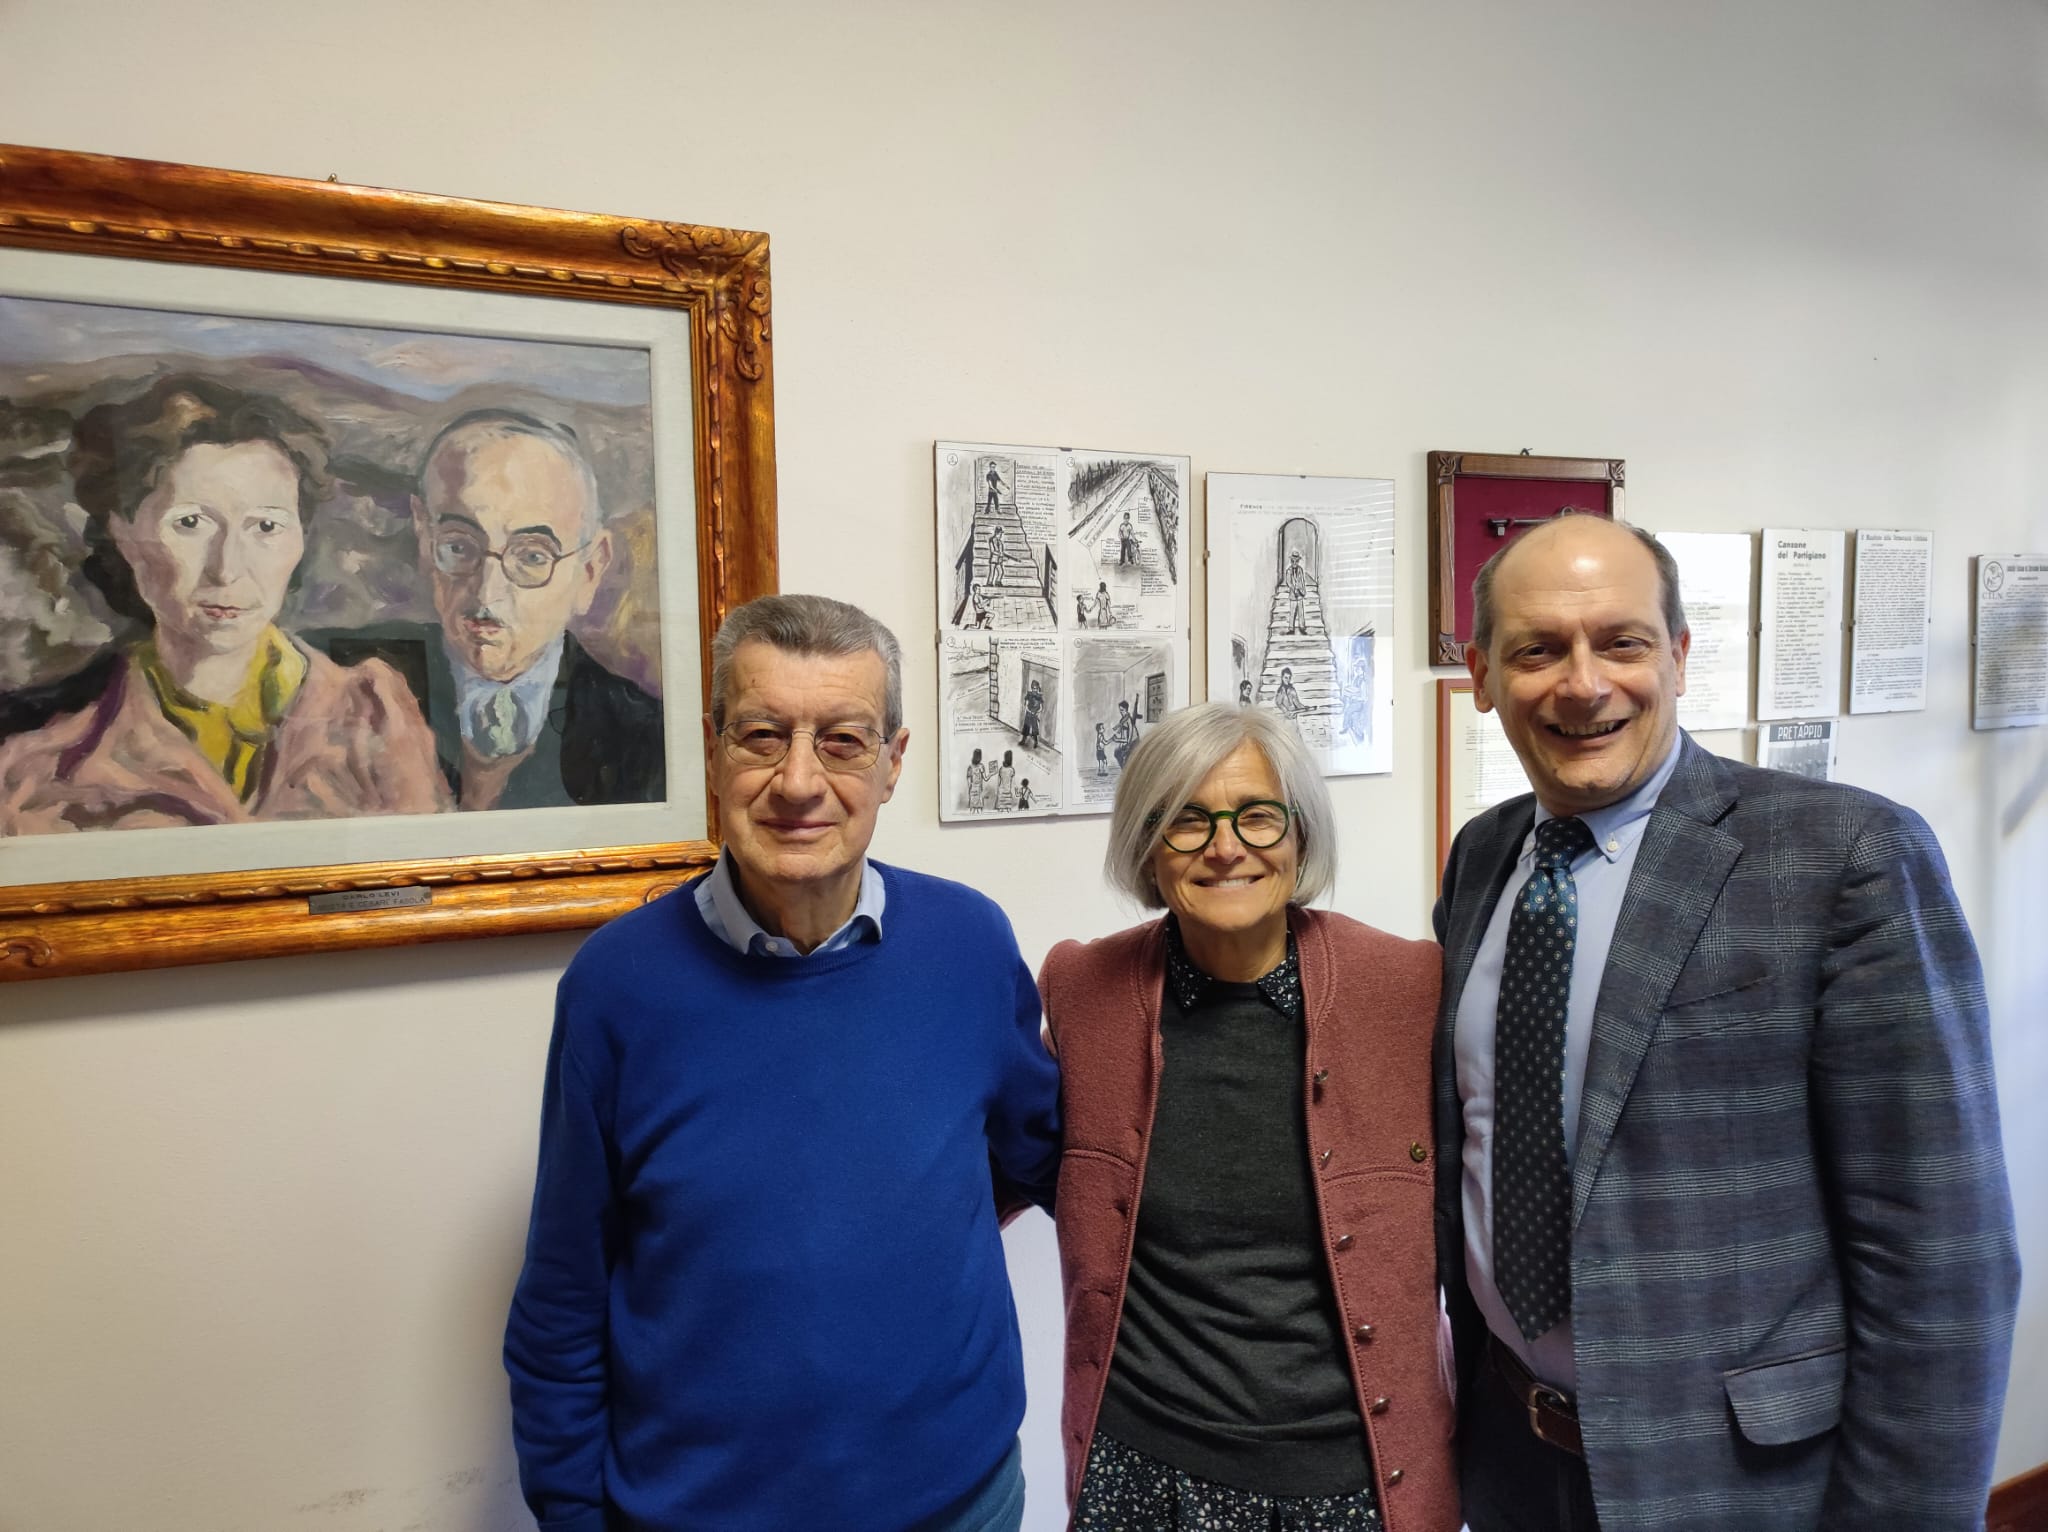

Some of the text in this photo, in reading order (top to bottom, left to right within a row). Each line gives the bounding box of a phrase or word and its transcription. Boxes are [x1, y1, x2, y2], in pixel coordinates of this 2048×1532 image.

[1777, 540, 1807, 549] Canzone
[1777, 551, 1827, 561] del Partigiano
[1778, 724, 1823, 740] PRETAPPIO
